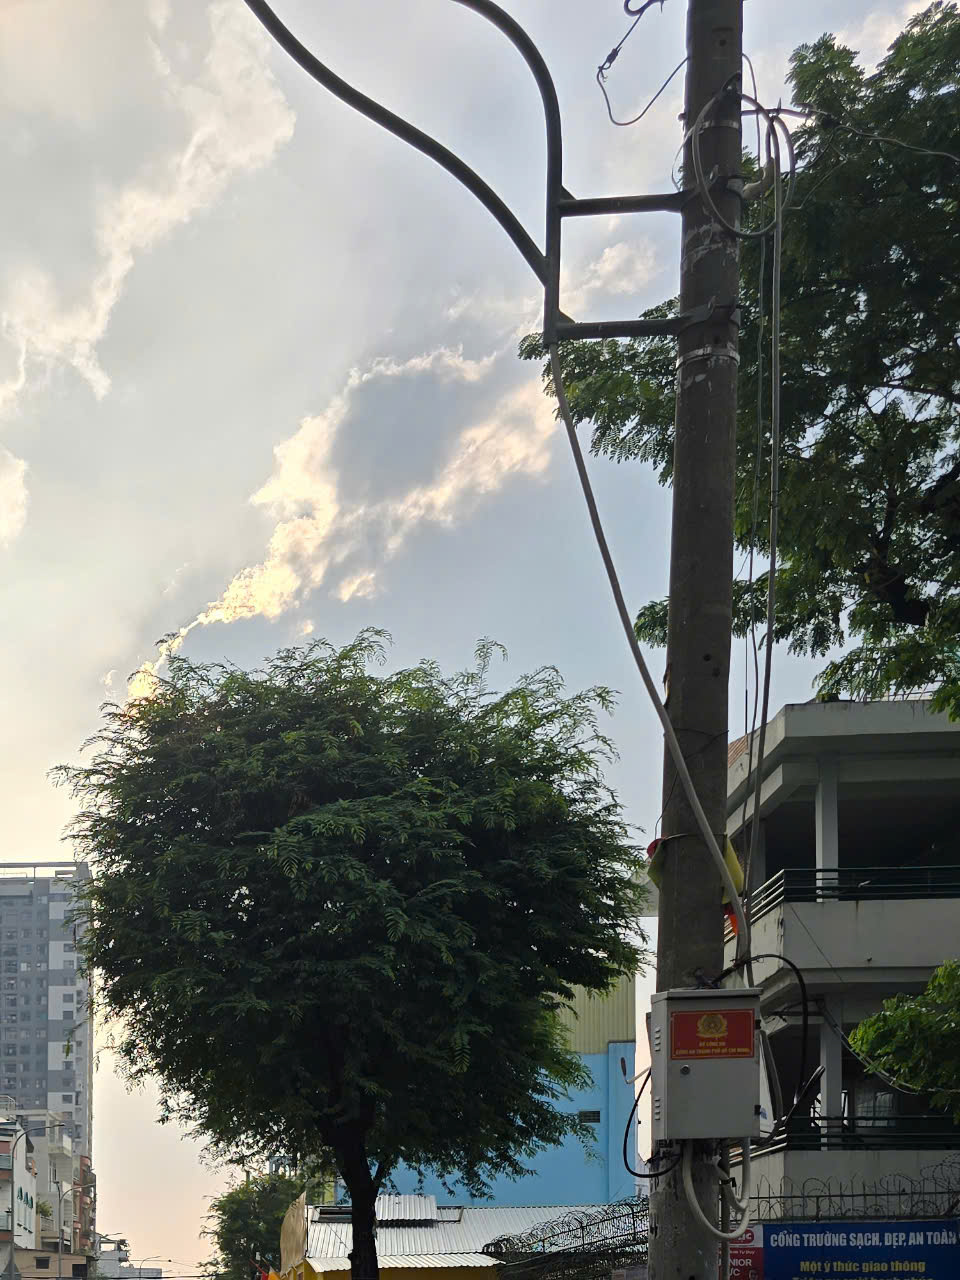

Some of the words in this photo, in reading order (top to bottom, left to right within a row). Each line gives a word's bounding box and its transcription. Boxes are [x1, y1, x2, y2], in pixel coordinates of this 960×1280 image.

[770, 1230, 800, 1247] CỔNG
[802, 1231, 847, 1246] TRƯỜNG
[849, 1232, 882, 1249] SẠCH,
[908, 1232, 924, 1245] AN
[800, 1261, 822, 1274] Một
[833, 1260, 859, 1272] thức
[862, 1261, 888, 1273] giao
[890, 1260, 926, 1273] thông
